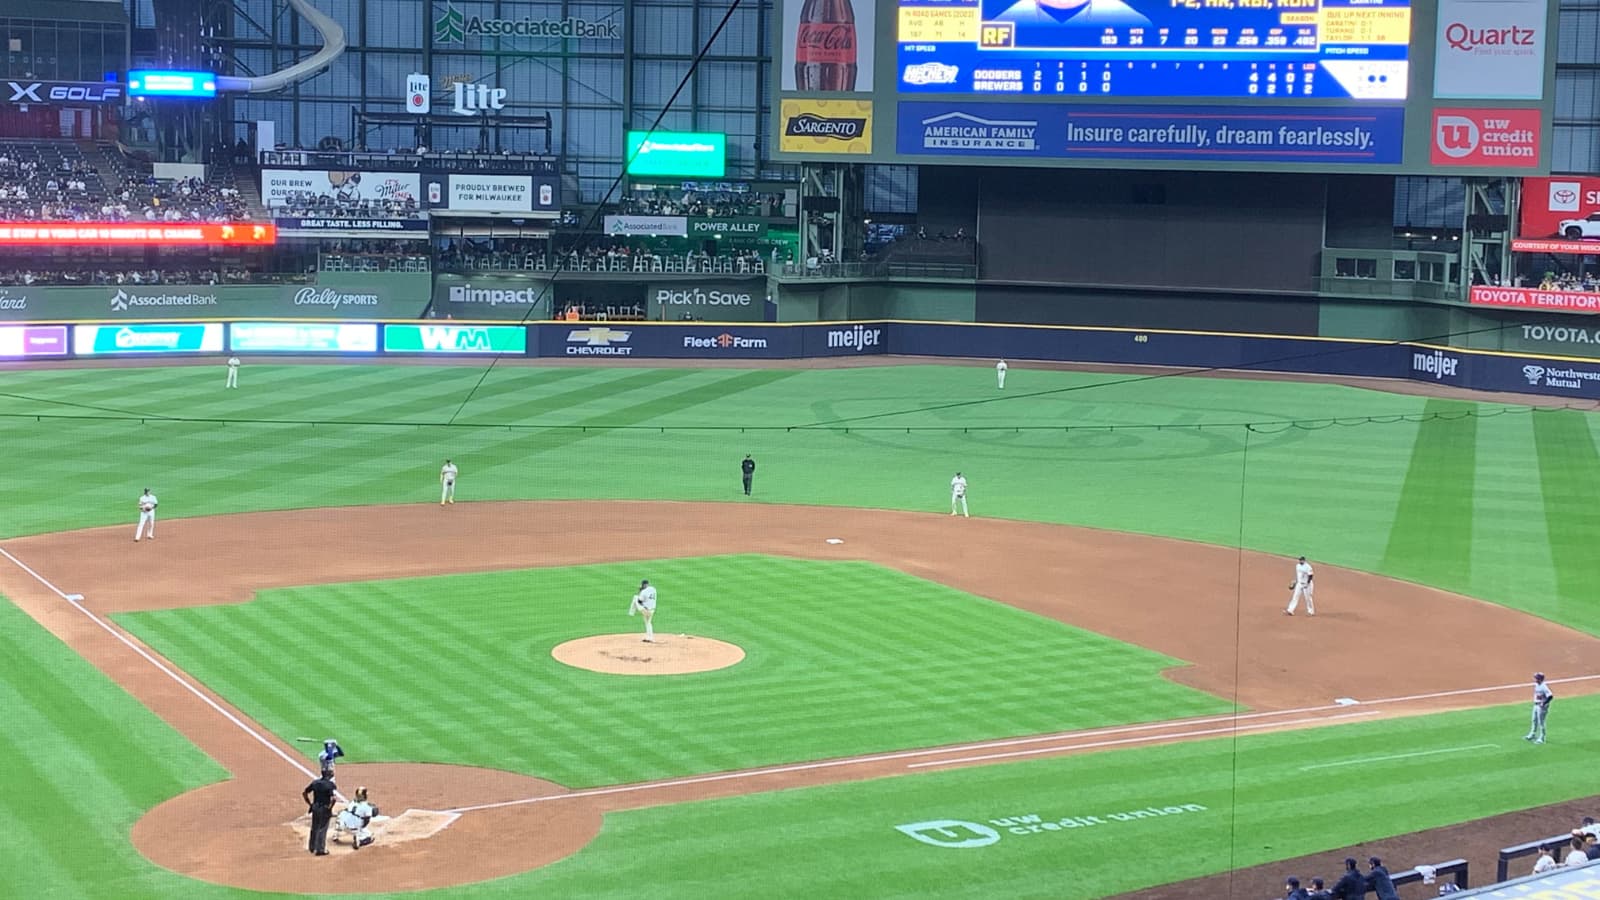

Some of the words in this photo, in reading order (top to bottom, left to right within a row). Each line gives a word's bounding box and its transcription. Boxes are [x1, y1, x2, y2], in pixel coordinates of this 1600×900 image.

[983, 27, 1010, 44] RF
[1160, 36, 1168, 45] 7
[1446, 22, 1535, 51] Quartz
[974, 70, 1021, 80] DODGERS
[1034, 70, 1042, 80] 2
[1058, 70, 1063, 80] 1
[1081, 71, 1086, 80] 1
[1103, 71, 1111, 81] 0
[1249, 72, 1258, 82] 4
[1267, 72, 1276, 82] 4
[1304, 73, 1313, 82] 2
[8, 82, 42, 101] X
[50, 87, 120, 101] GOLF
[410, 82, 428, 93] Lite
[973, 81, 1023, 91] BREWERS
[1033, 82, 1041, 91] 0
[1056, 82, 1064, 92] 0
[1079, 82, 1087, 92] 0
[1102, 82, 1110, 92] 0
[1248, 84, 1258, 94] 0
[1267, 84, 1276, 94] 2
[1287, 84, 1293, 94] 1
[1304, 84, 1312, 94] 2
[452, 82, 506, 116] Lite
[1484, 120, 1510, 129] uw
[924, 126, 987, 137] AMERICAN
[992, 128, 1035, 138] FAMILY
[1068, 123, 1122, 142] Insure
[1128, 125, 1211, 147] carefully,
[1216, 126, 1273, 145] dream
[1278, 127, 1374, 150] fearlessly.
[1483, 130, 1533, 142] credit
[932, 139, 1026, 148] INSURANCE
[1482, 144, 1534, 156] union
[301, 220, 325, 228] GREAT
[327, 220, 351, 228] TASTE.
[352, 220, 371, 228] LESS
[372, 220, 404, 228] FILLING.
[694, 223, 728, 231] POWER
[730, 224, 760, 232] ALLEY
[294, 288, 342, 309] Bally
[342, 295, 378, 305] SPORTS
[466, 284, 534, 305] impact
[709, 291, 751, 305] Save
[1474, 290, 1526, 304] TOYOTA
[684, 337, 717, 348] Fleet
[733, 337, 767, 348] Farm
[828, 325, 881, 351] meijer
[566, 346, 632, 355] CHEVROLET
[1413, 350, 1458, 379] meijer
[1546, 378, 1581, 389] Mutual
[1008, 816, 1107, 835] credit
[1107, 804, 1207, 821] union
